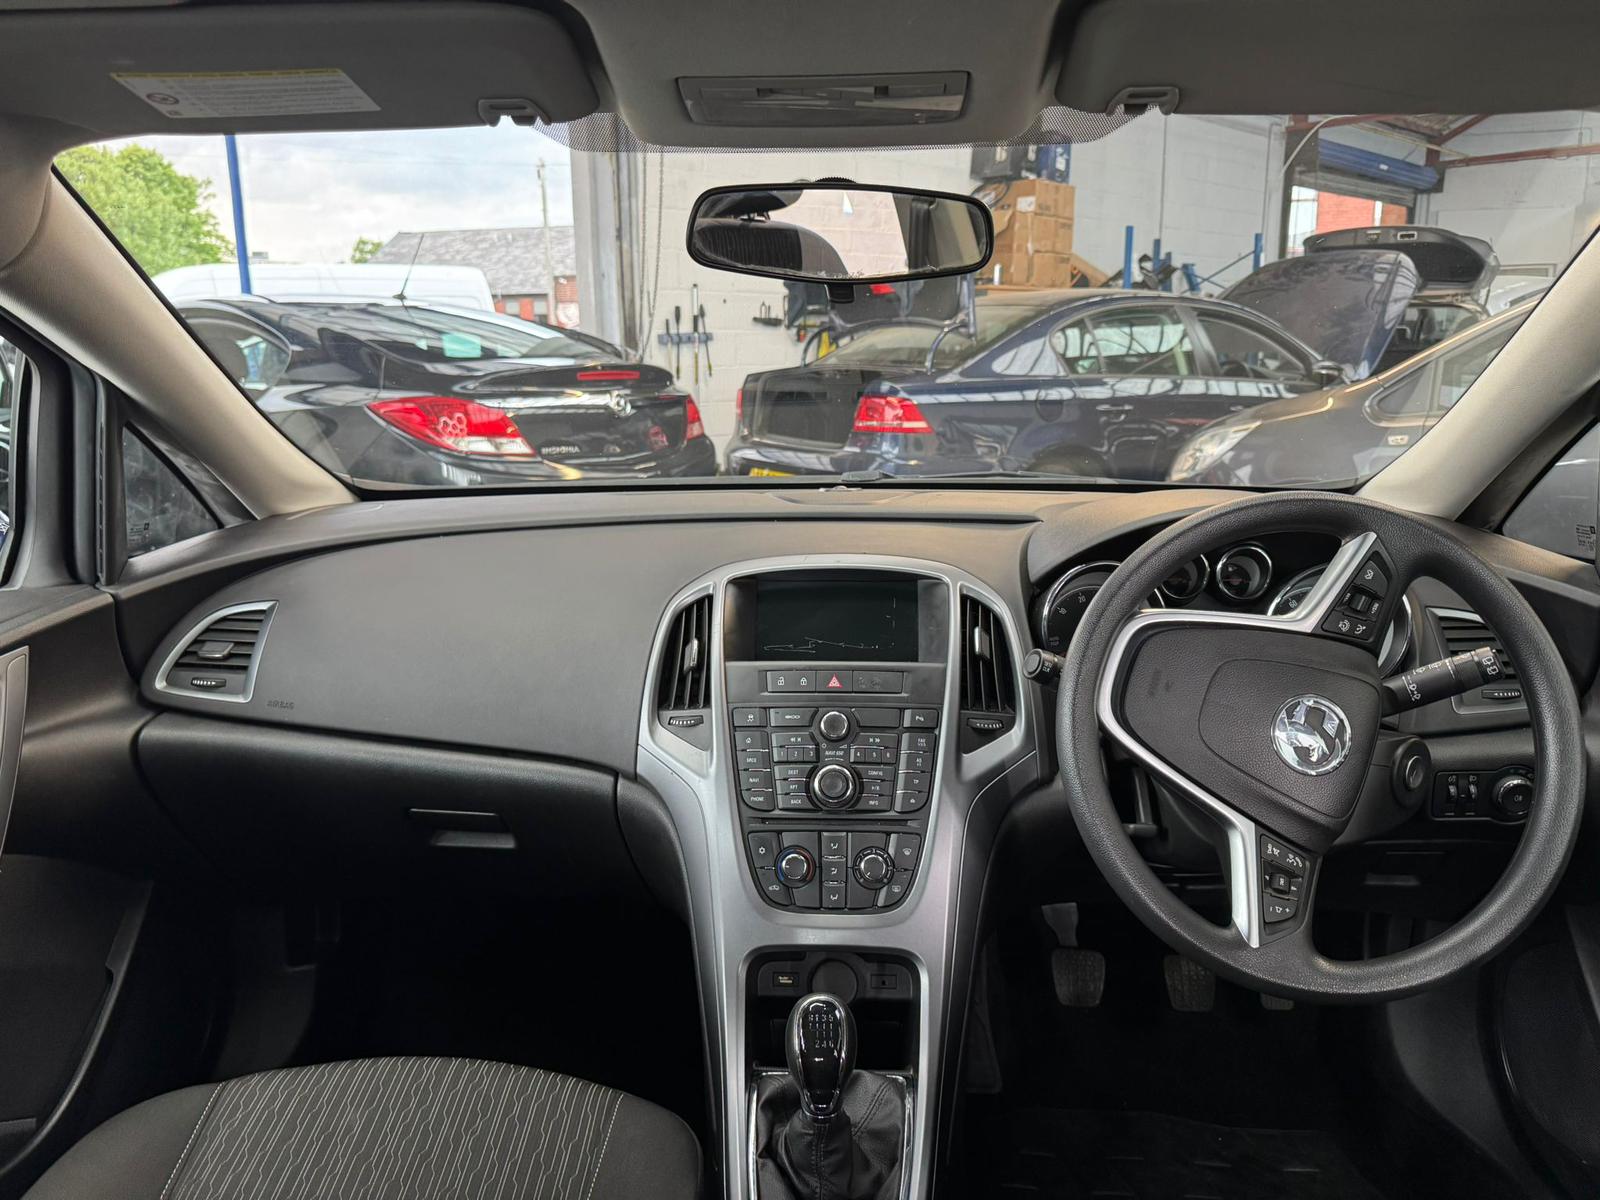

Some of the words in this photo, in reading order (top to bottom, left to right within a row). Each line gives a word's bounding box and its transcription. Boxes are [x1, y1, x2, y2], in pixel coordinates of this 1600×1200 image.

[541, 446, 580, 455] INSIGNIA
[821, 1014, 827, 1022] 3
[828, 1014, 834, 1022] 5
[815, 1040, 820, 1048] 2
